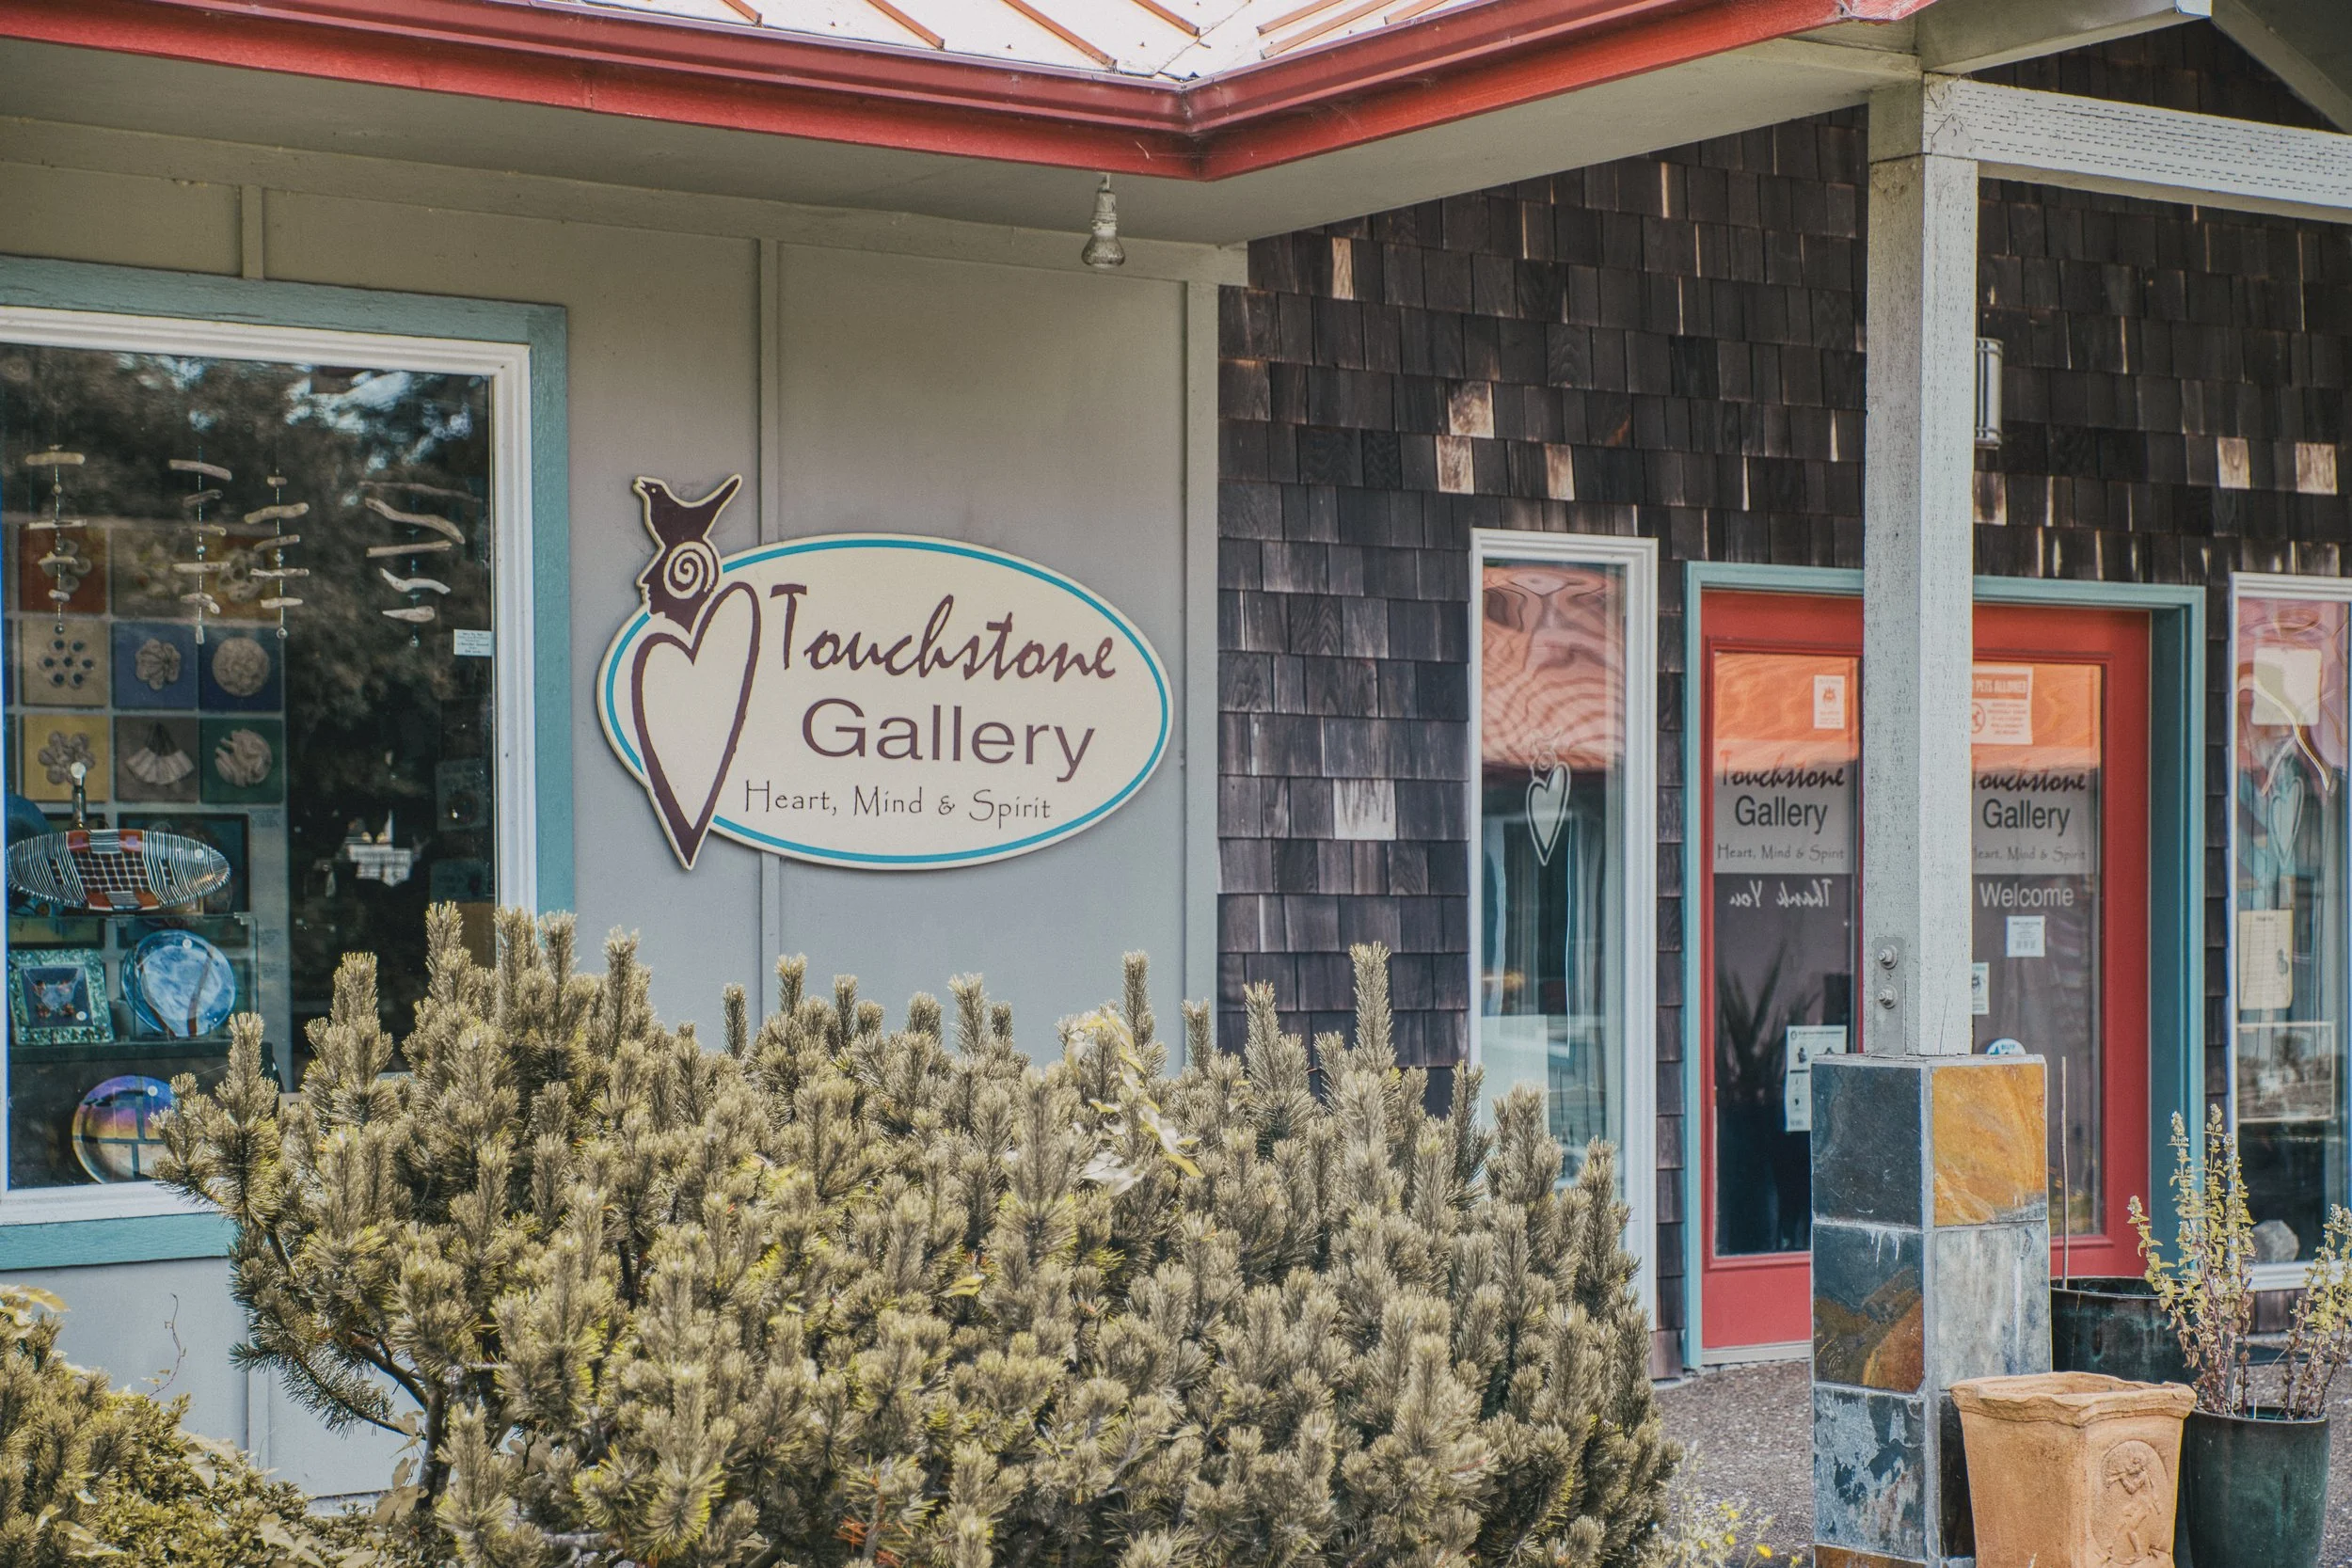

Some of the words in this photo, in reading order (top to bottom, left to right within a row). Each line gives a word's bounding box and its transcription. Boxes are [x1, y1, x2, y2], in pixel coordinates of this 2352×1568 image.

[770, 583, 1117, 682] Touchstone
[802, 698, 1095, 783] Gallery
[1720, 750, 1845, 789] Touchstone
[745, 780, 837, 816] Heart,
[853, 785, 922, 816] Mind
[938, 796, 956, 816] &
[969, 789, 1051, 830] Spirit
[1735, 795, 1828, 835] Gallery
[1983, 799, 2071, 837] Gallery
[1717, 844, 1756, 860] Heart,
[1761, 845, 1791, 860] Mind
[1796, 848, 1805, 858] &
[1809, 844, 1845, 864] Spirit
[1974, 847, 2003, 860] eart,
[2007, 847, 2036, 861] Mind
[2052, 847, 2086, 865] Spirit
[1979, 882, 2074, 907] Welcome
